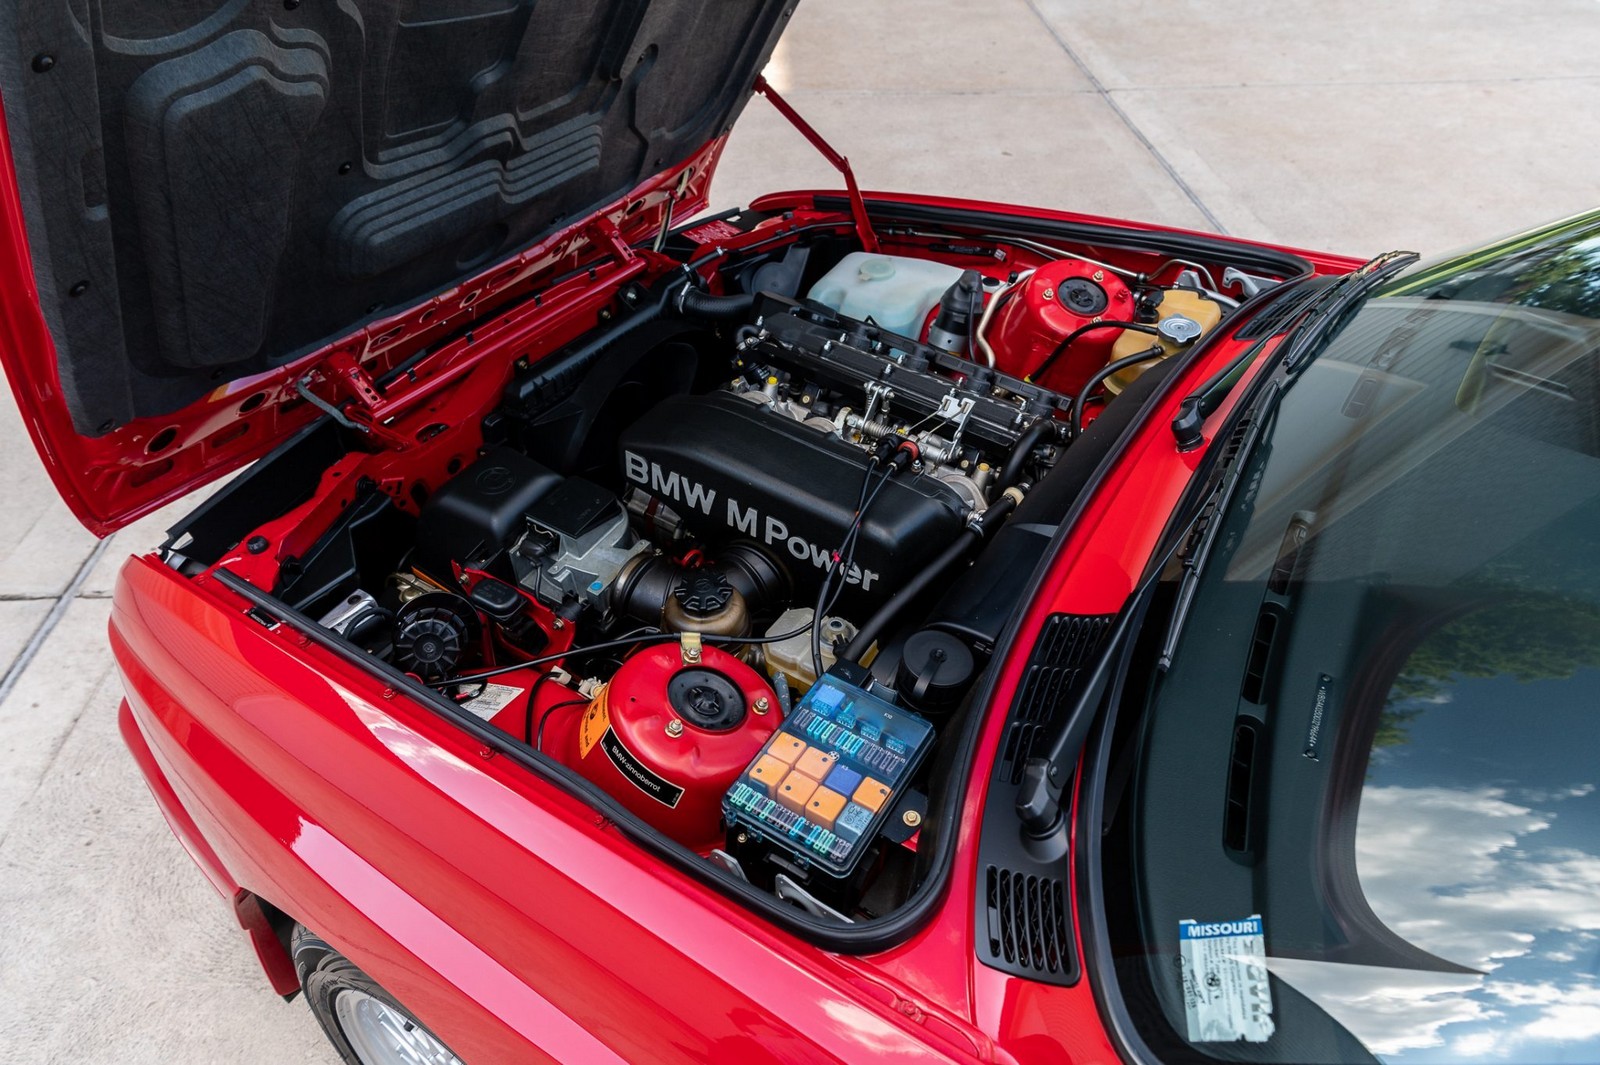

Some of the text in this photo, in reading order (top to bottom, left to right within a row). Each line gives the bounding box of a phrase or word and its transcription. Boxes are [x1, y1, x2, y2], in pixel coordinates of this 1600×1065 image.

[625, 450, 879, 592] BMW M Power
[612, 745, 661, 792] BMW-zinnoberrot
[1188, 922, 1258, 937] MISSOURI
